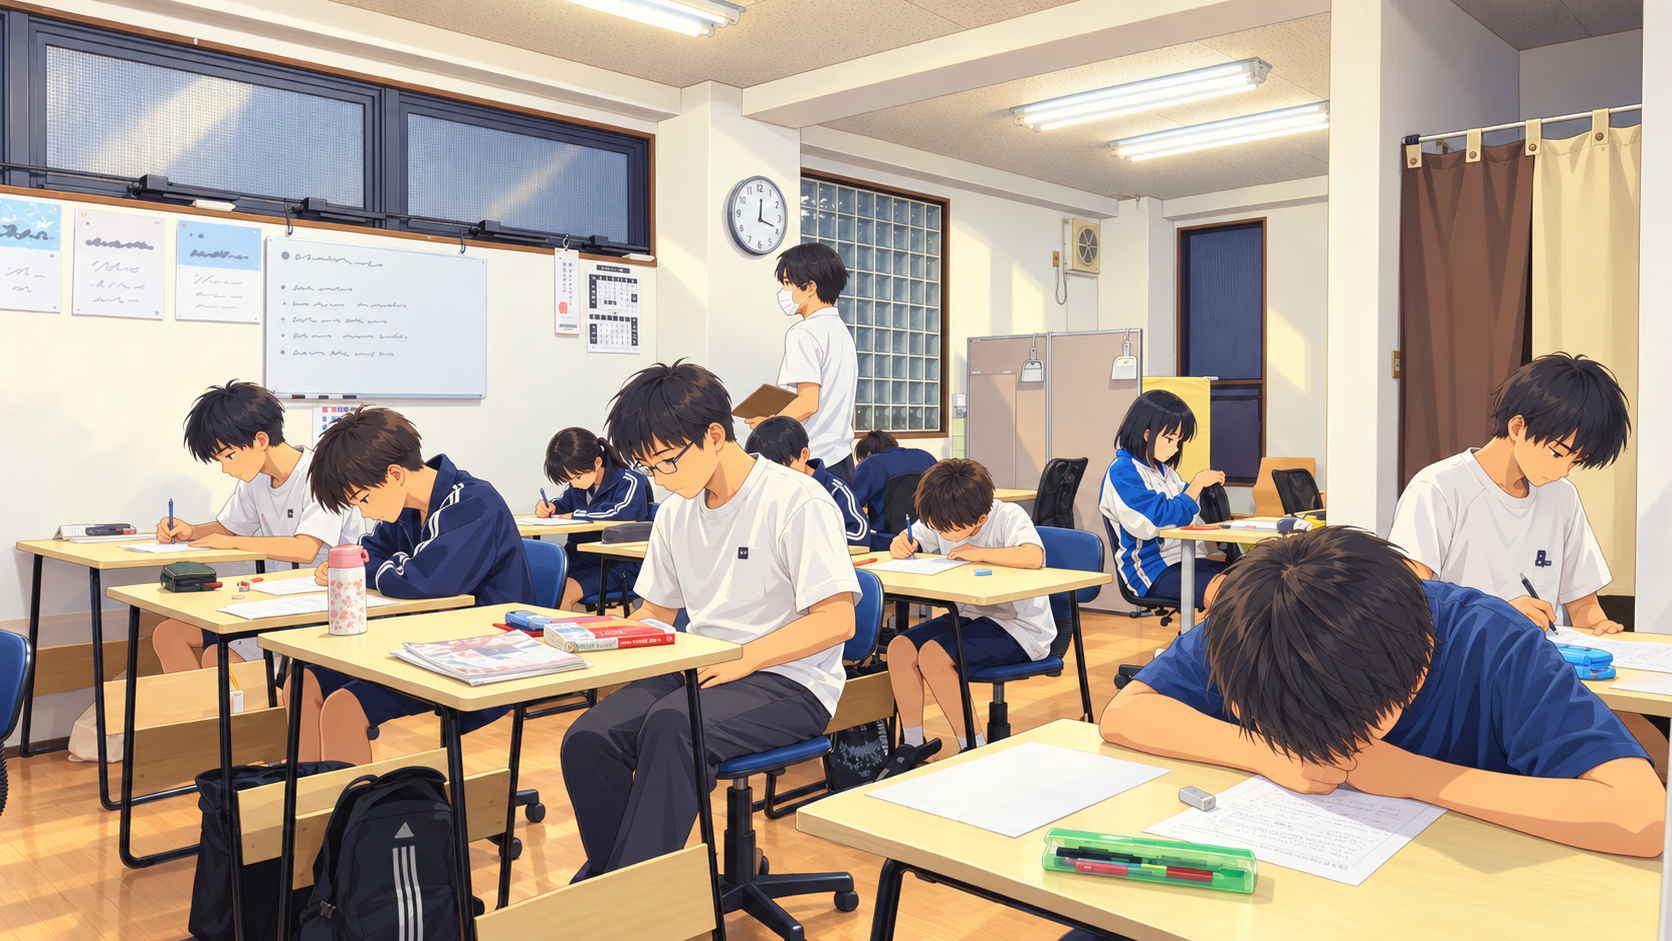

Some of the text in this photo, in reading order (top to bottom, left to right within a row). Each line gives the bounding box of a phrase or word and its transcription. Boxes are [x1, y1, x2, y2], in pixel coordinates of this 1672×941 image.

[747, 186, 752, 195] 11
[757, 183, 764, 193] 12
[739, 195, 747, 204] 10
[775, 201, 780, 209] 2
[736, 208, 741, 218] 9
[777, 215, 782, 223] 3
[747, 235, 752, 244] 7
[757, 240, 762, 250] 6
